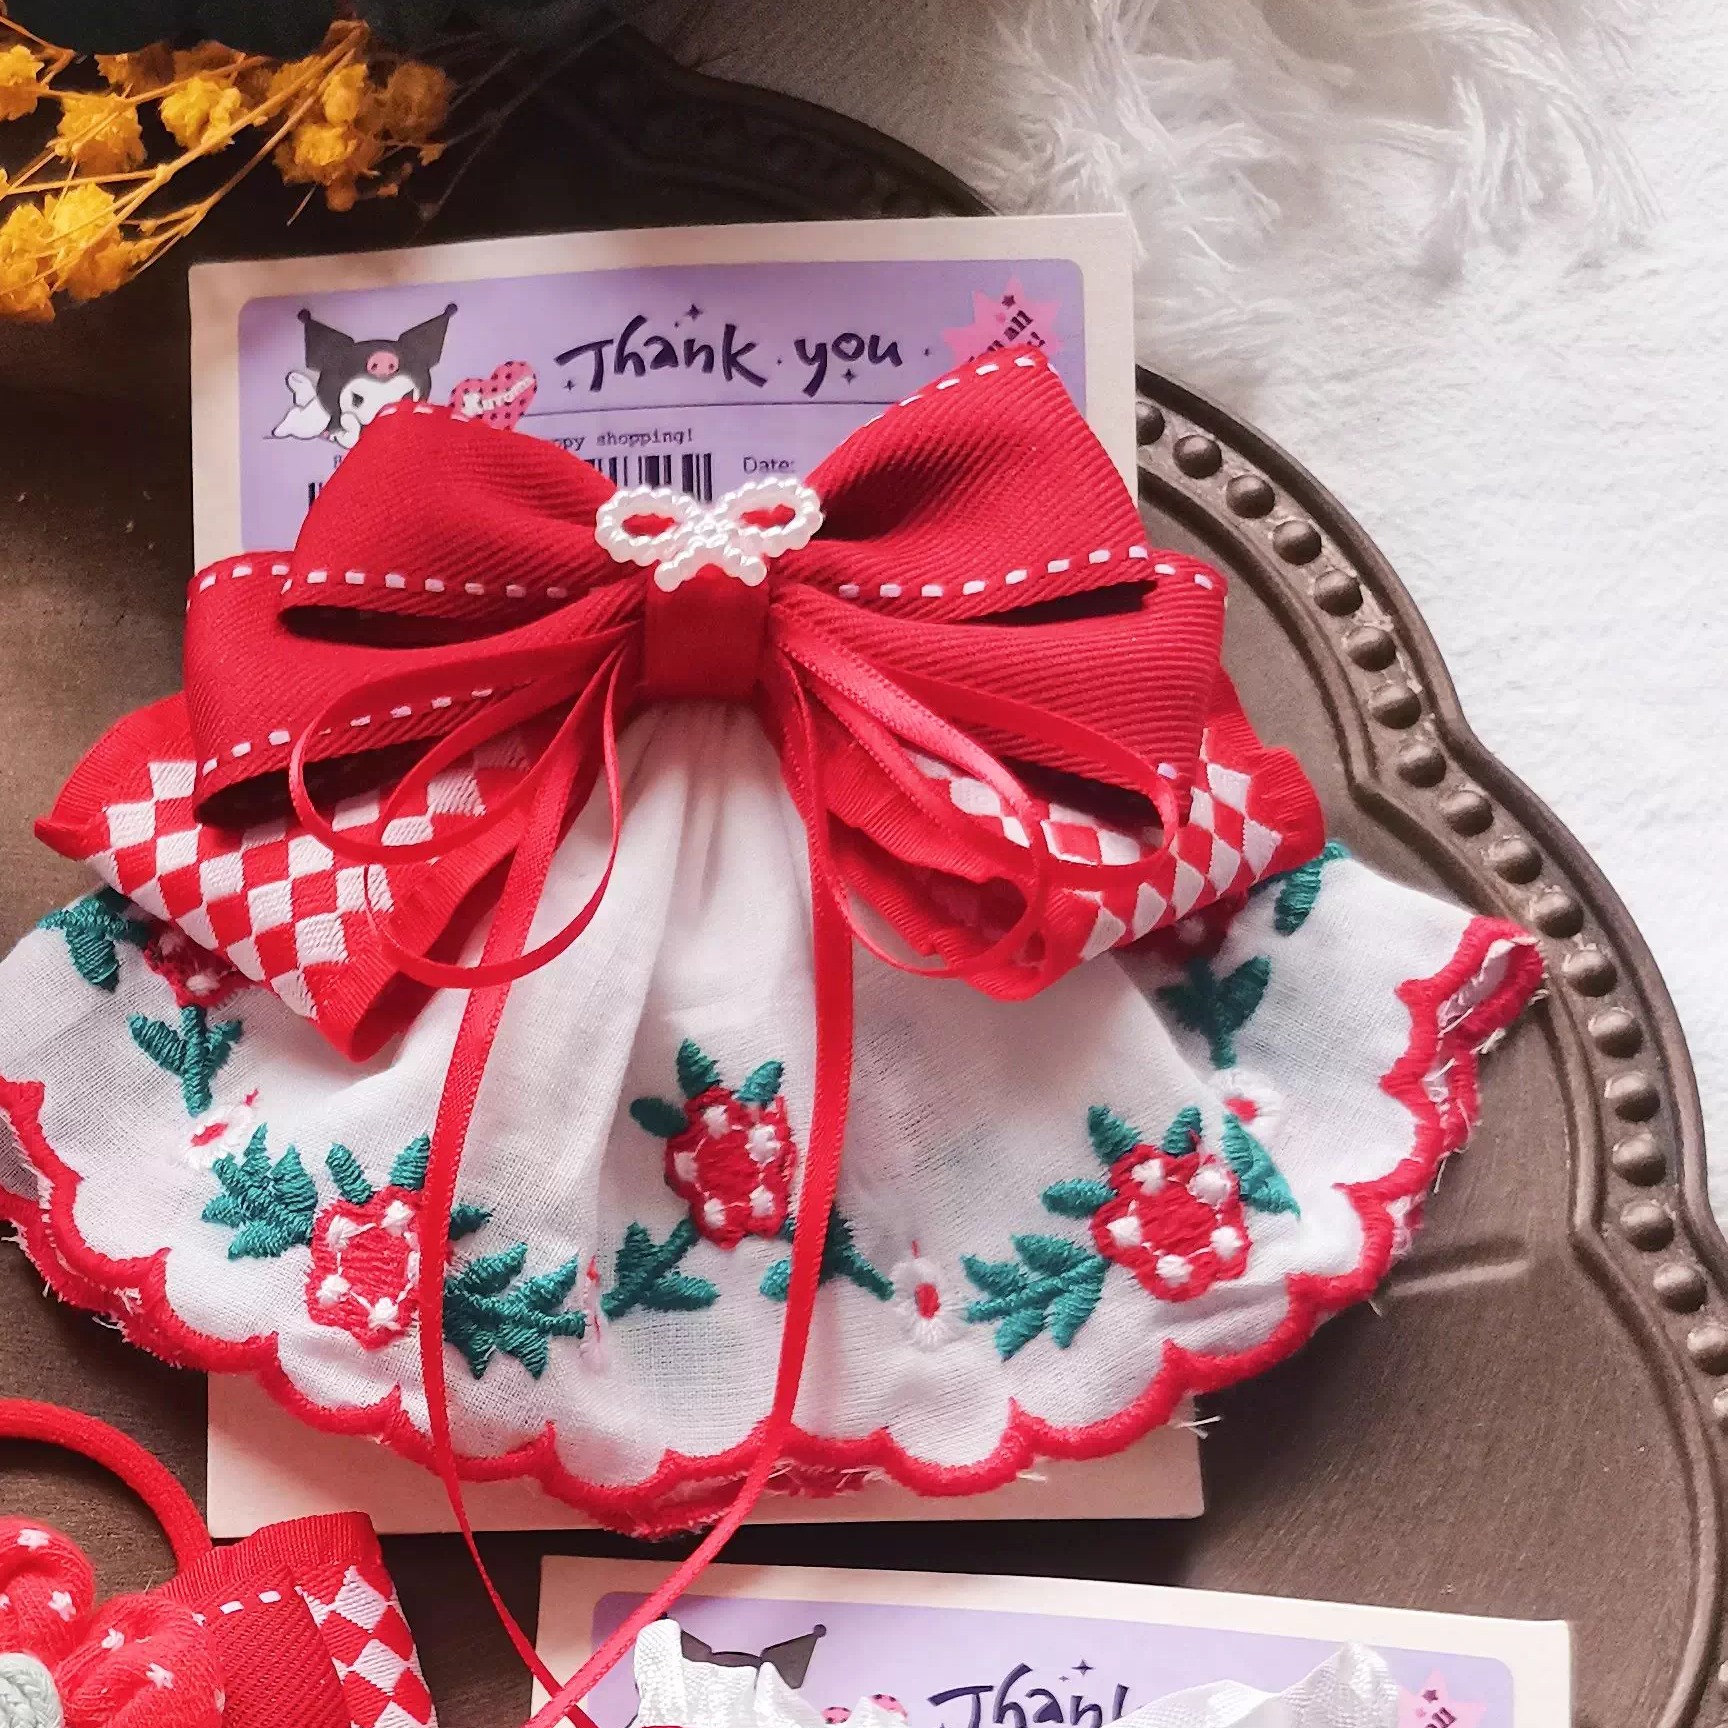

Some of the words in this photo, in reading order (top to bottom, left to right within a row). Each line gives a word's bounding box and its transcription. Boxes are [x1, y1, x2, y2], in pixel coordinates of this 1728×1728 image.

[554, 315, 767, 392] Thank
[794, 332, 903, 397] you
[596, 428, 693, 448] shopping!
[743, 456, 795, 474] Date:
